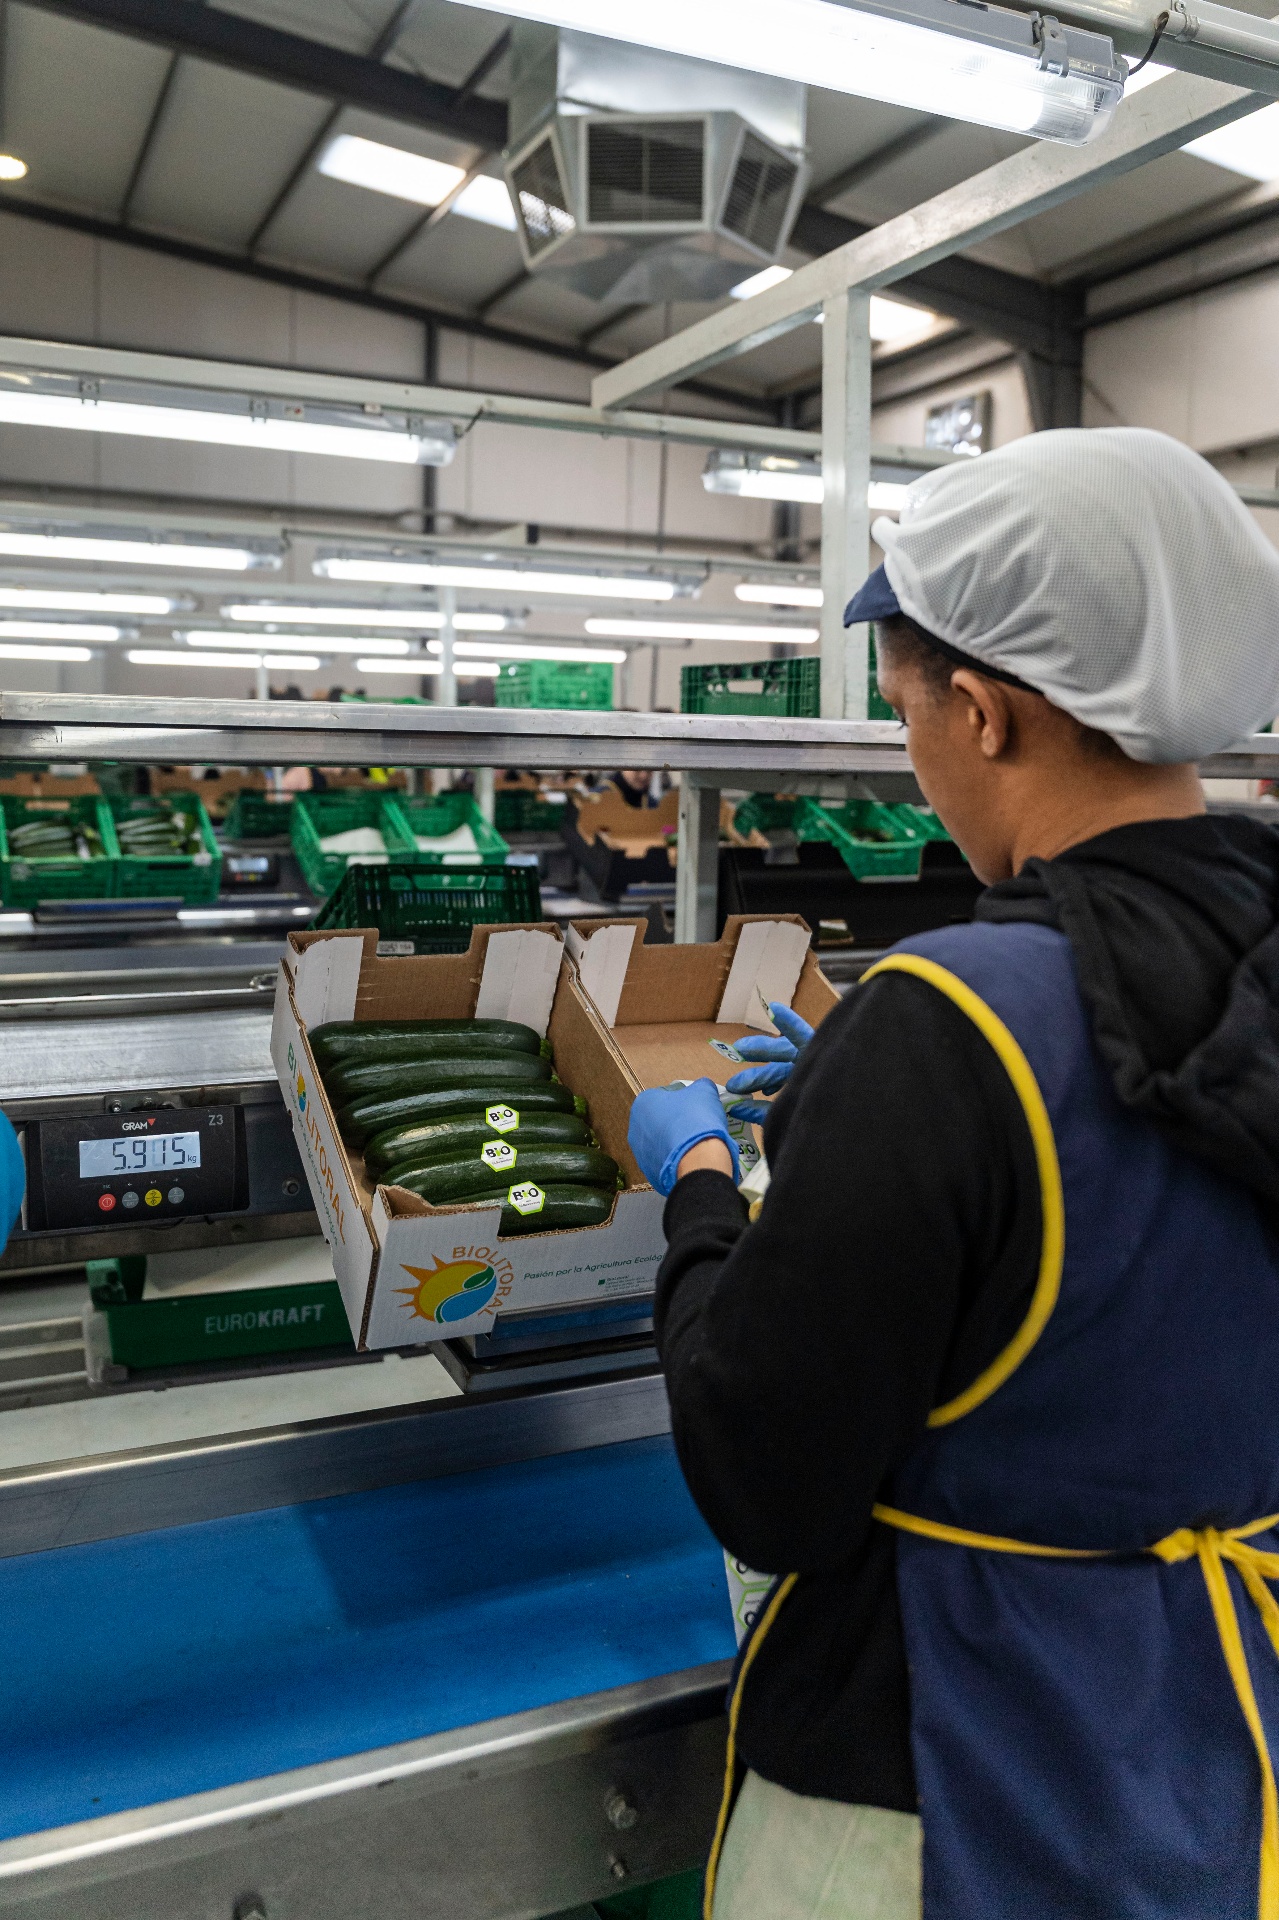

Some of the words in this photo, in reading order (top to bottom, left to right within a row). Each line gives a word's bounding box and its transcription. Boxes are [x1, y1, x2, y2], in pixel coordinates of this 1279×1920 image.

[122, 1121, 148, 1131] GRAM
[208, 1114, 224, 1126] Z3
[113, 1136, 186, 1170] 5.915
[187, 1154, 197, 1163] kg
[452, 1245, 514, 1317] BIOLITORAL
[523, 1270, 554, 1280] Pasión
[555, 1268, 573, 1277] por
[573, 1265, 583, 1273] la
[583, 1259, 632, 1272] Agricultura
[204, 1303, 326, 1334] EUROKRAFT
